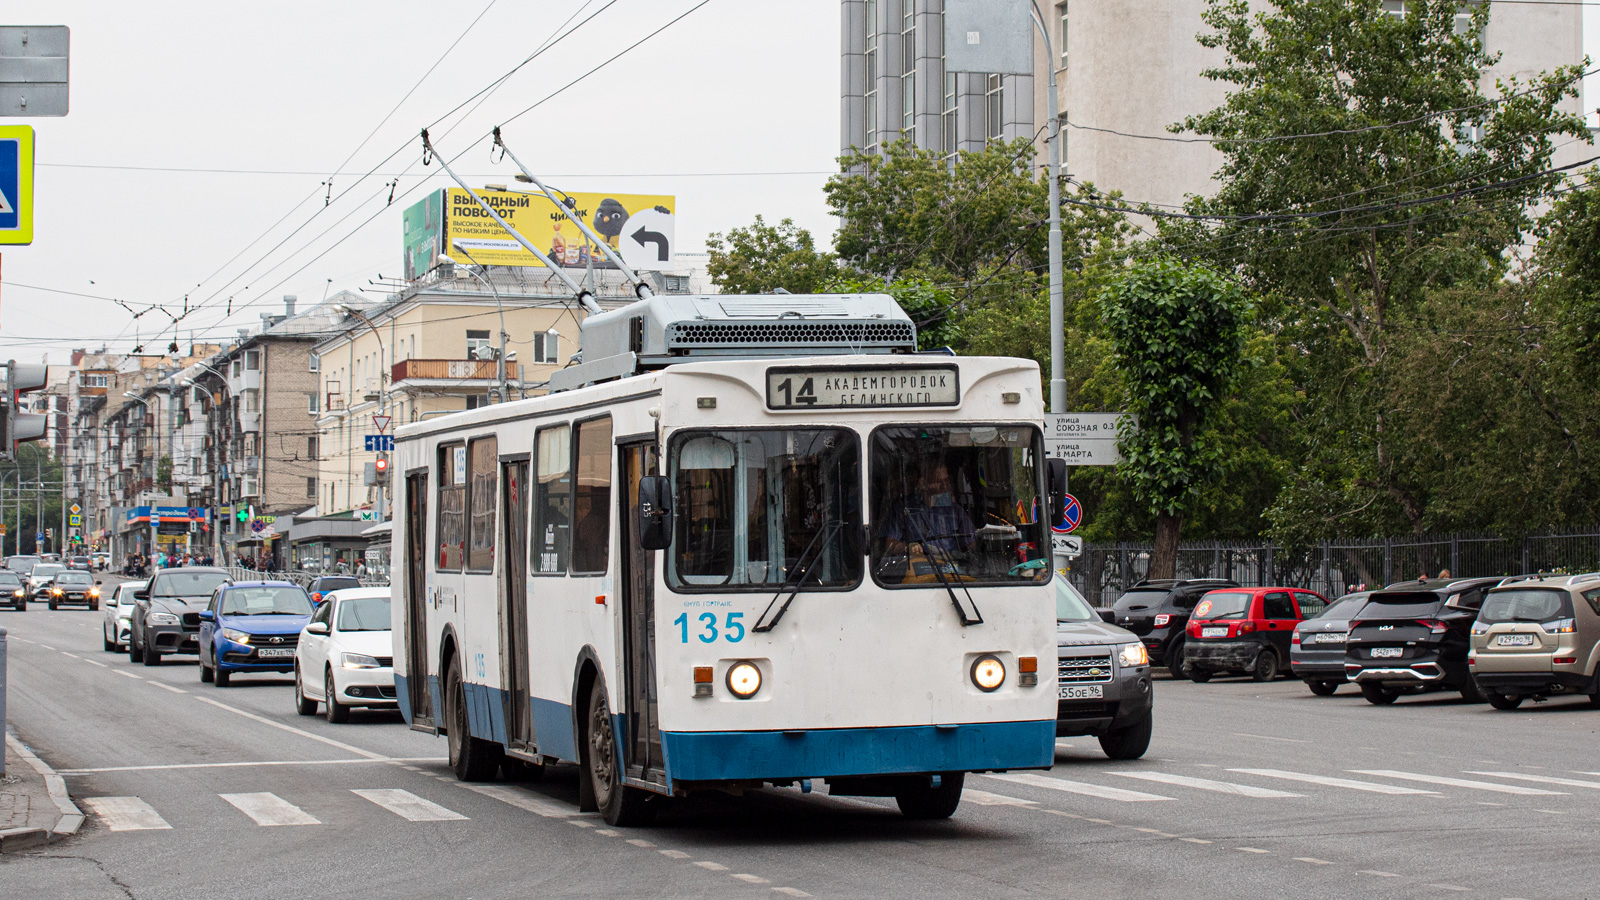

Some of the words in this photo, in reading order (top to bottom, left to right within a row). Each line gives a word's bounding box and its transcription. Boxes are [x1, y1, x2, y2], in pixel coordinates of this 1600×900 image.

[550, 209, 588, 222] Чиик
[777, 377, 818, 406] 14
[825, 375, 947, 391] АКАДЕМГОРОДОК
[841, 392, 931, 405] БЕЛИНСКОГО
[1056, 424, 1098, 432] СОЮЗНАЯ
[455, 449, 466, 473] 135
[642, 501, 652, 518] 135
[674, 612, 745, 644] 135
[474, 653, 486, 679] 135
